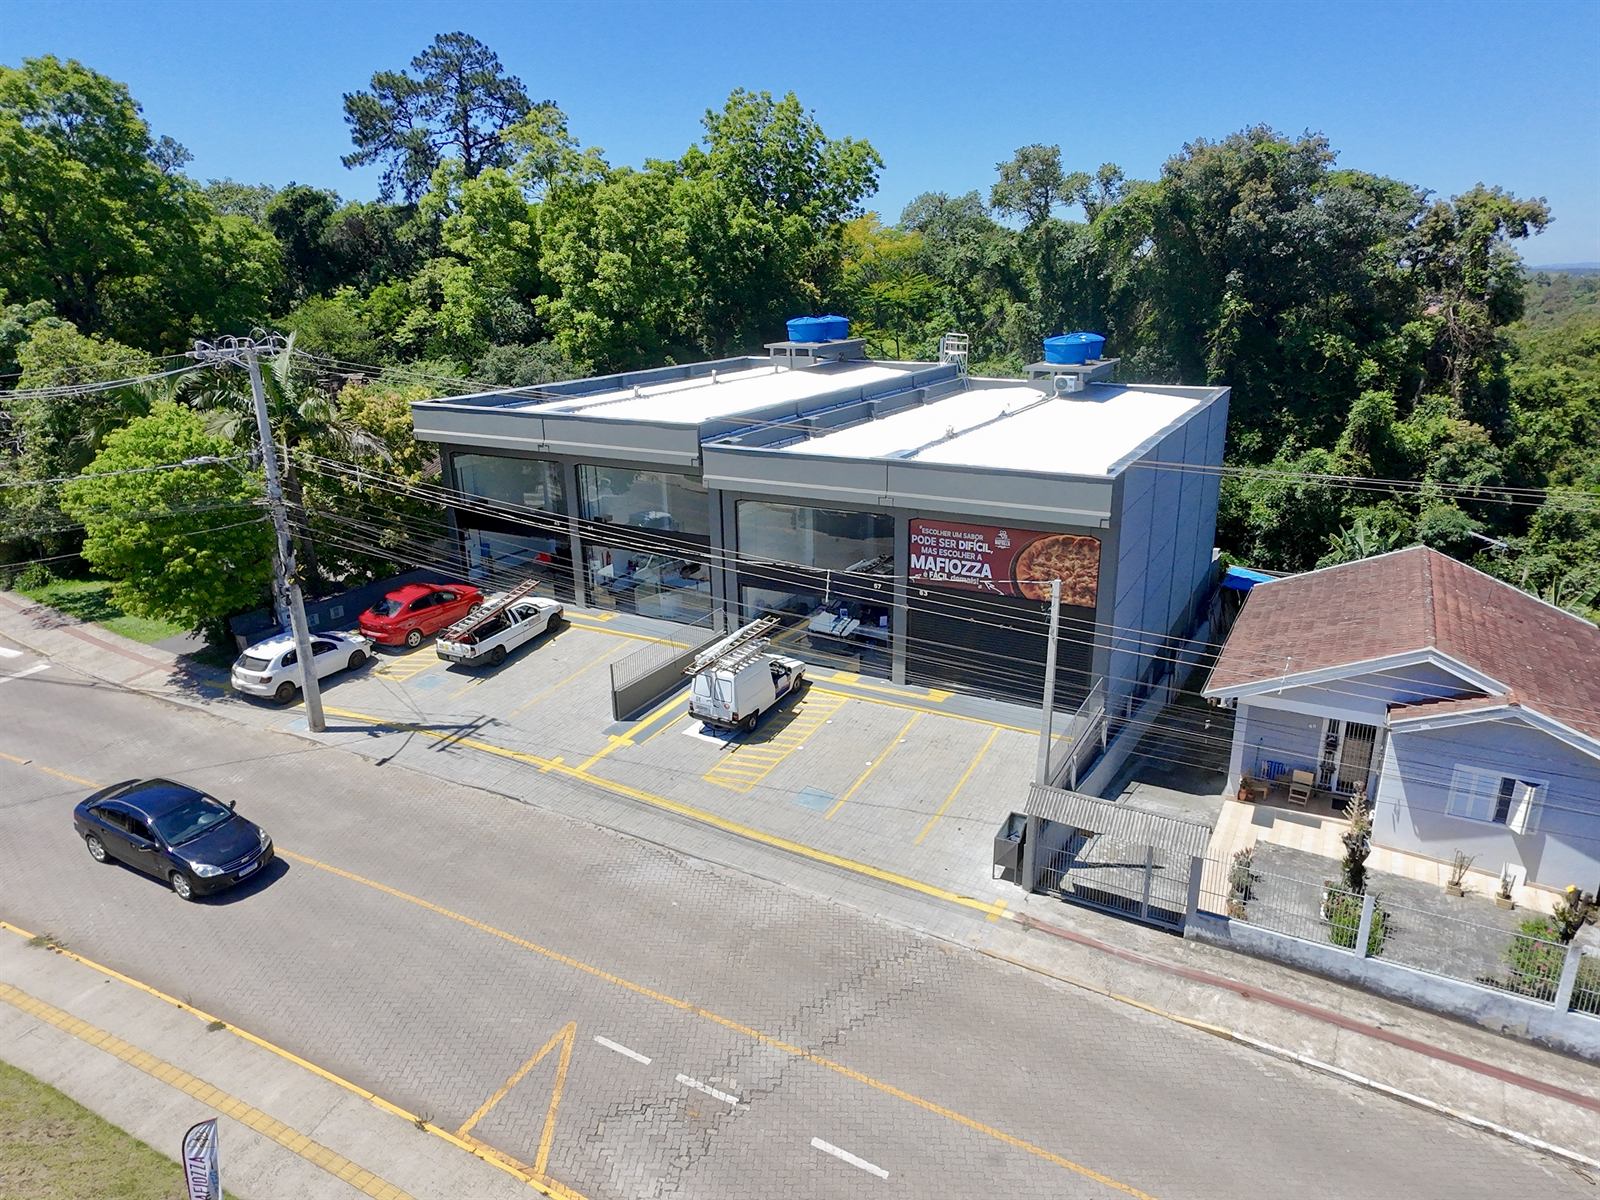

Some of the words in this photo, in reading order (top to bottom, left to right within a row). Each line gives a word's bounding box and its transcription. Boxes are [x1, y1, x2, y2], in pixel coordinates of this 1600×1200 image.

[921, 527, 951, 537] ESCOLHER
[963, 532, 984, 541] SABOR
[911, 534, 937, 546] PODE
[938, 538, 957, 549] SER
[958, 538, 994, 555] DIFÍCIL,
[921, 546, 938, 555] MAS
[938, 549, 976, 560] ESCOLHER
[976, 553, 983, 561] A
[910, 554, 993, 578] MAFIOZZA
